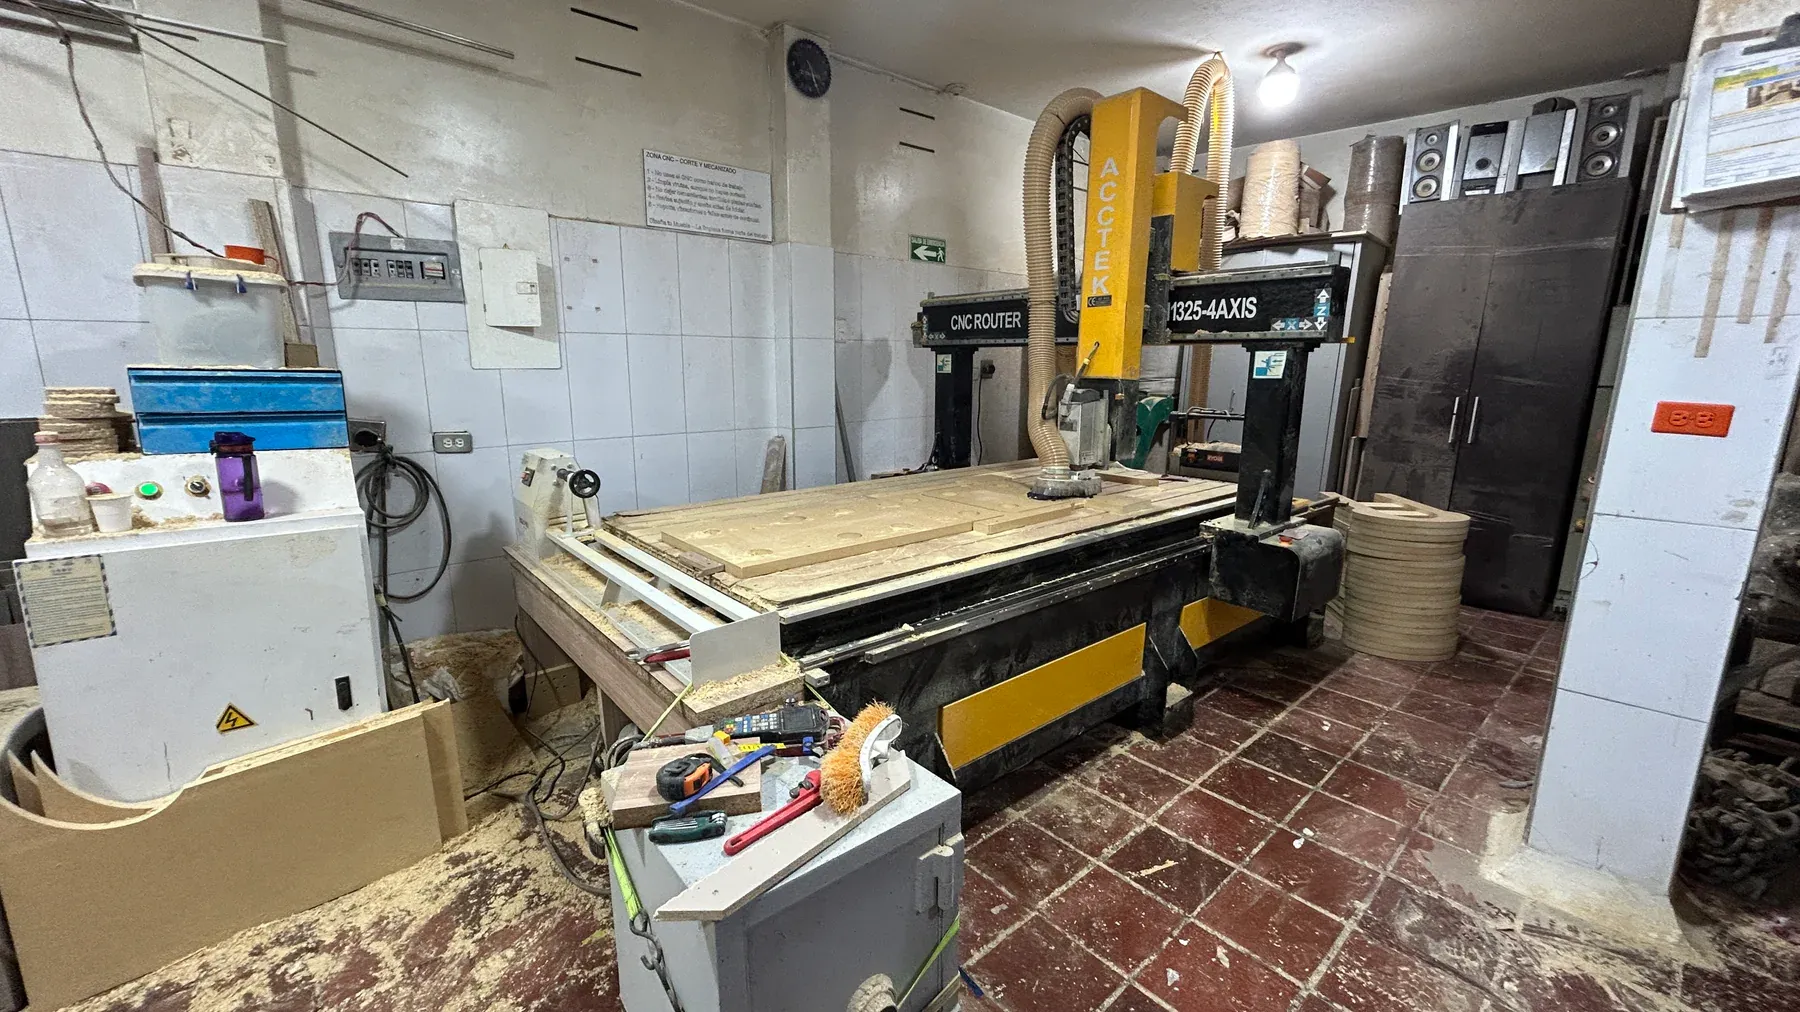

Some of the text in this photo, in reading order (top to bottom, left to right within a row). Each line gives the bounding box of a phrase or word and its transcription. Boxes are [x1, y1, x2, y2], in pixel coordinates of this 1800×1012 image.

[704, 163, 736, 174] MECANIZADO
[1092, 157, 1119, 294] ACCTEK
[1167, 297, 1257, 321] 1325-4AXIS
[950, 312, 1021, 330] CNC ROUTER
